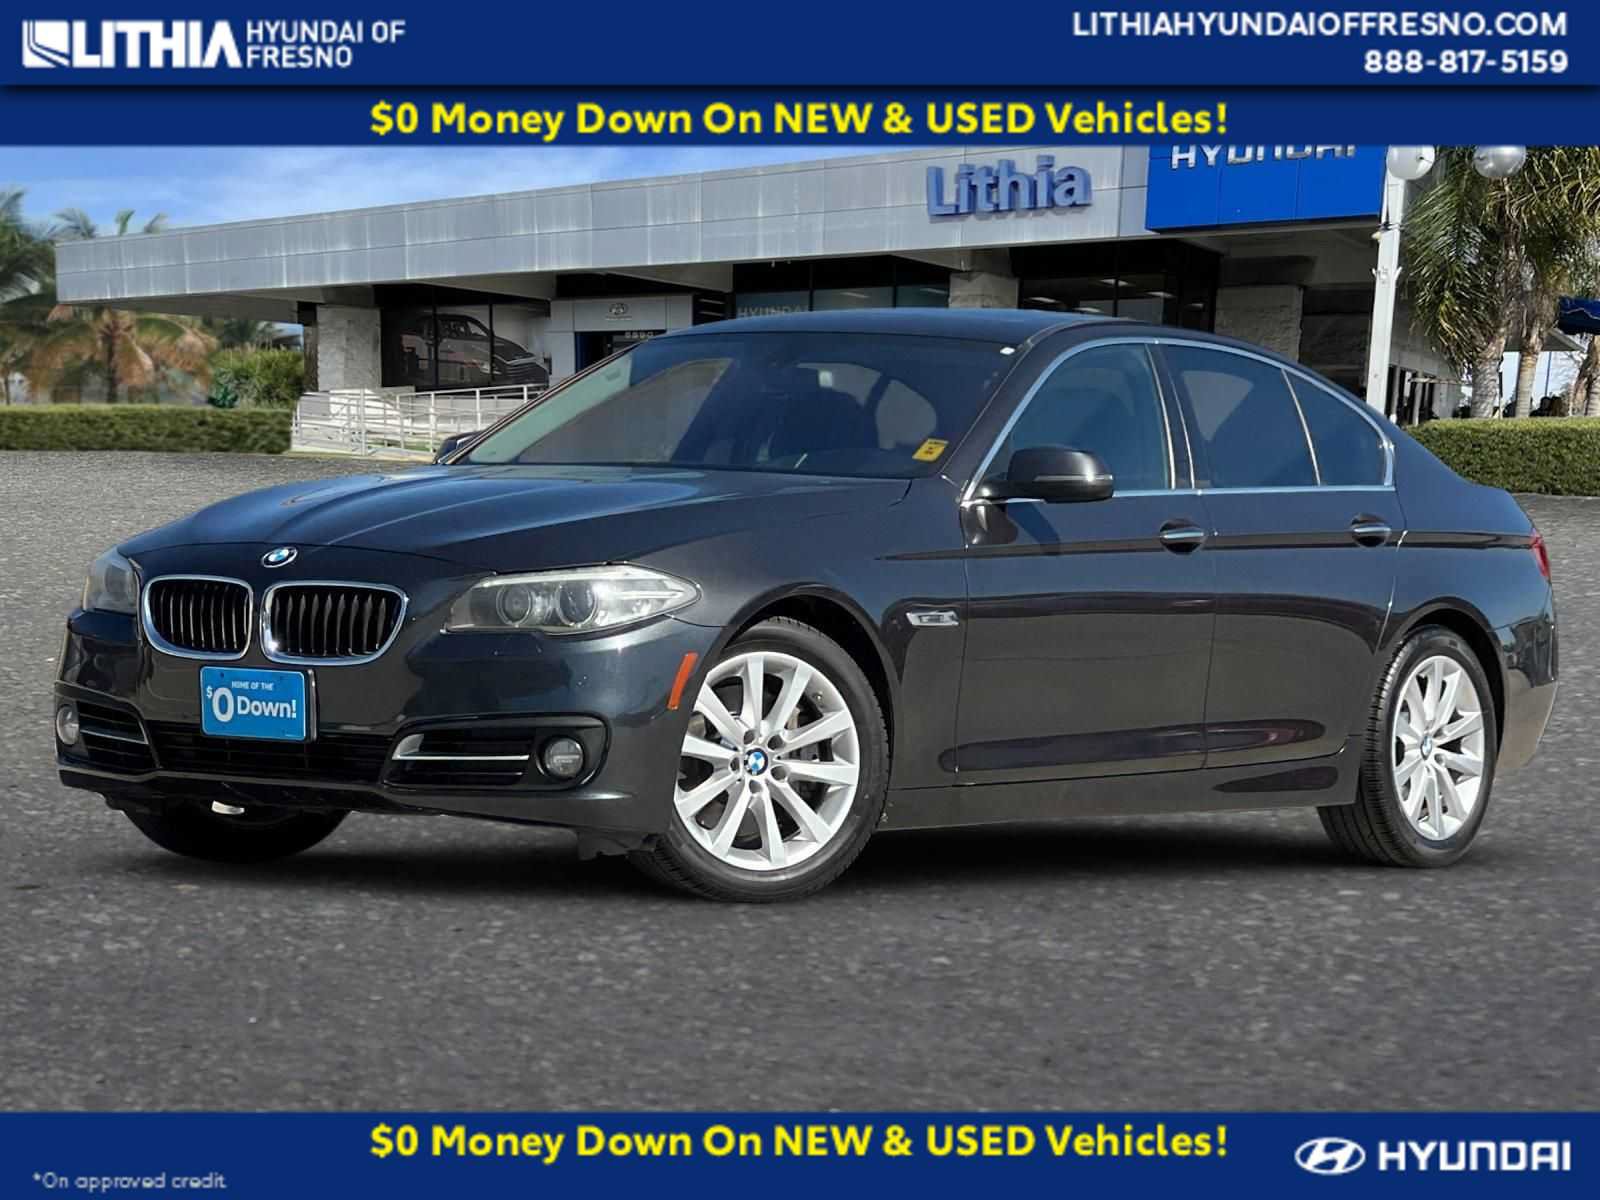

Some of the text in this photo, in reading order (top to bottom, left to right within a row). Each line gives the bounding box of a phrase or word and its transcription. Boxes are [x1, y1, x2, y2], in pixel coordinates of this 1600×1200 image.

[927, 154, 1093, 217] Lithia
[231, 680, 275, 691] HOME OF THE
[206, 686, 296, 722] $0 Down!
